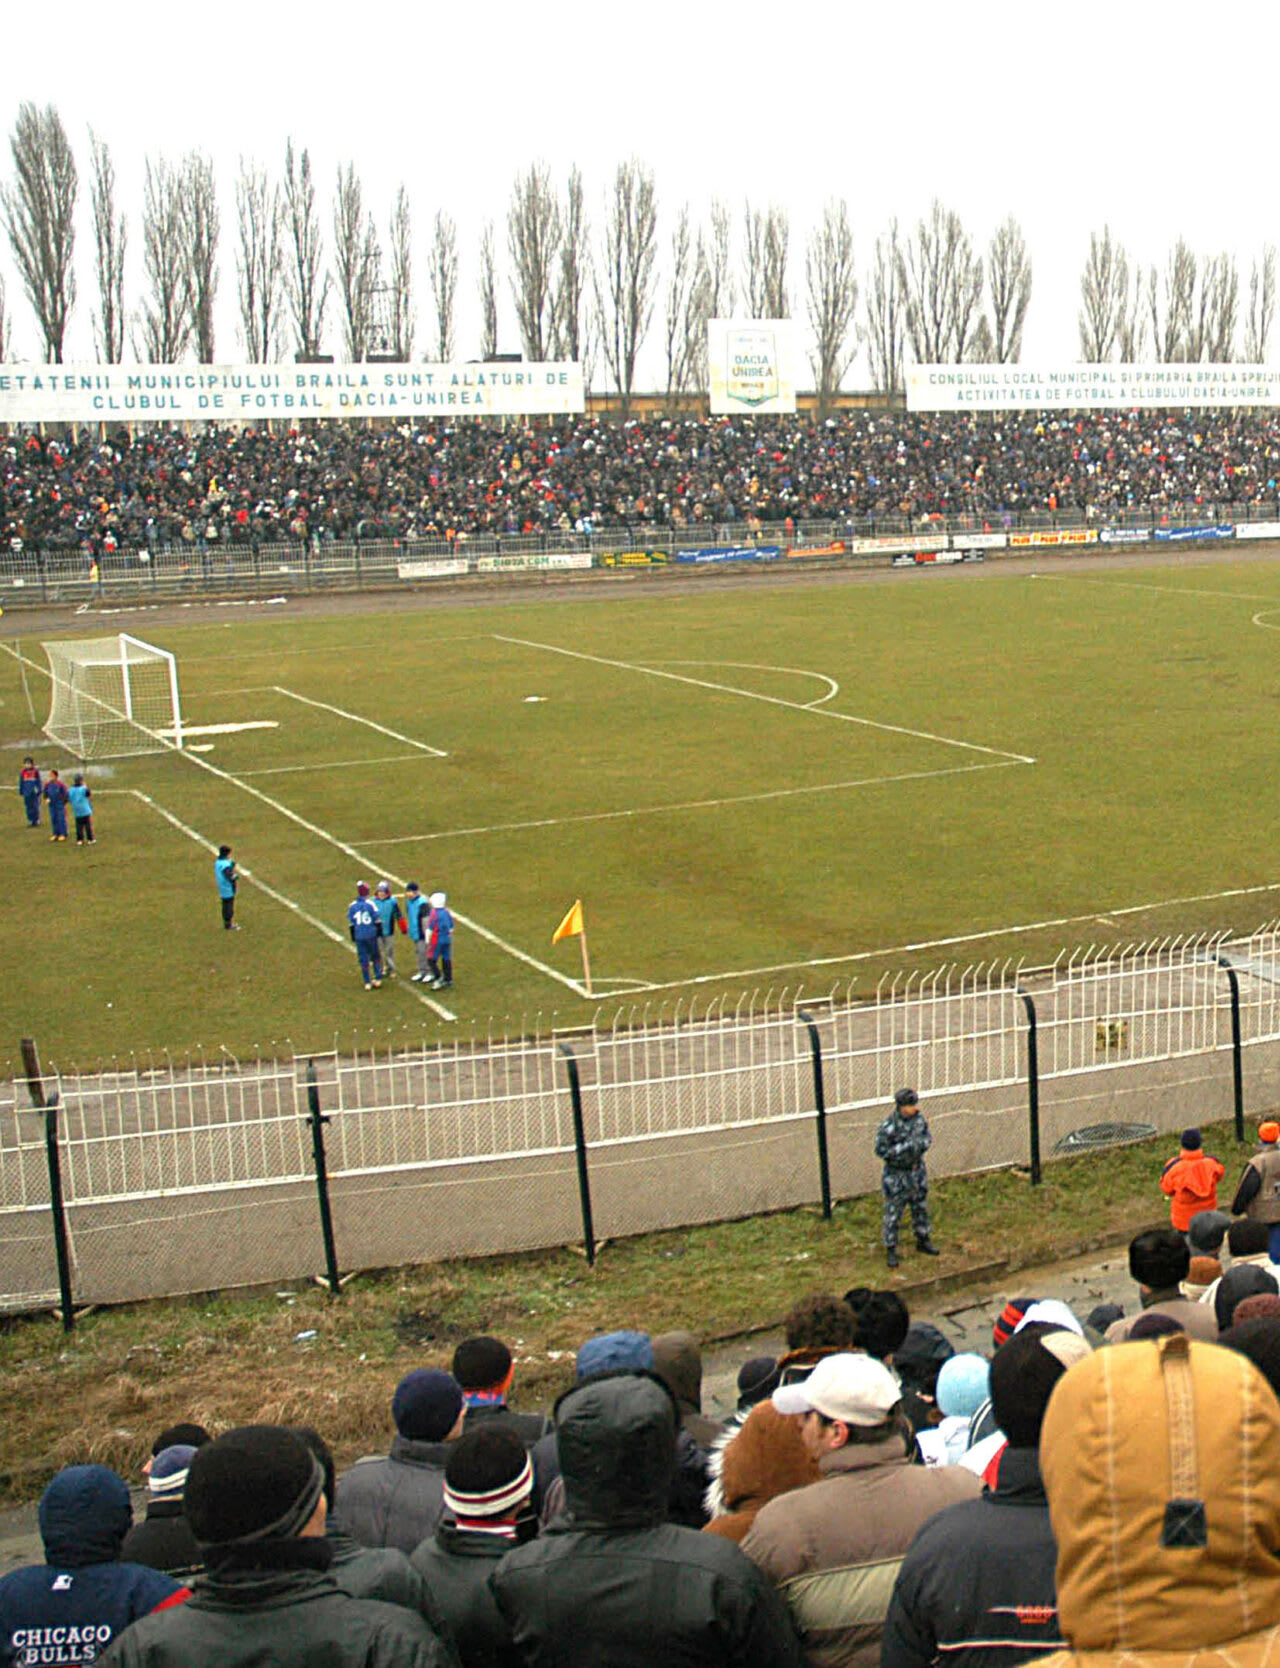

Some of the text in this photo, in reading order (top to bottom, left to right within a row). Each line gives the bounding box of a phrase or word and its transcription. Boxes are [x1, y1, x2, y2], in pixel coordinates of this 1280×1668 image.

[734, 355, 769, 365] DACIA
[731, 367, 773, 377] UNIREA
[928, 373, 999, 385] CONSILIUL
[1004, 373, 1044, 384] LOCAL
[1050, 372, 1116, 384] MUNICIPAL
[1121, 372, 1132, 383] SI
[1136, 372, 1192, 383] PRIMARIA
[1197, 371, 1237, 383] BRAILA
[127, 374, 281, 390] MUNICIPIULUI
[295, 373, 370, 388] BRAILA
[384, 373, 436, 388] SUNT
[451, 372, 533, 387] ALATURI
[546, 372, 569, 386] DE
[92, 391, 483, 410] CLUBUL DE FOTBAL DACIA-UNIREA
[957, 386, 1271, 401] ACTIVITATEA DE FOTBAL A CLUBULUI DACIA-UNIREA
[353, 911, 372, 925] 16
[11, 1624, 112, 1648] CHICAGO
[24, 1644, 96, 1665] BULLS
